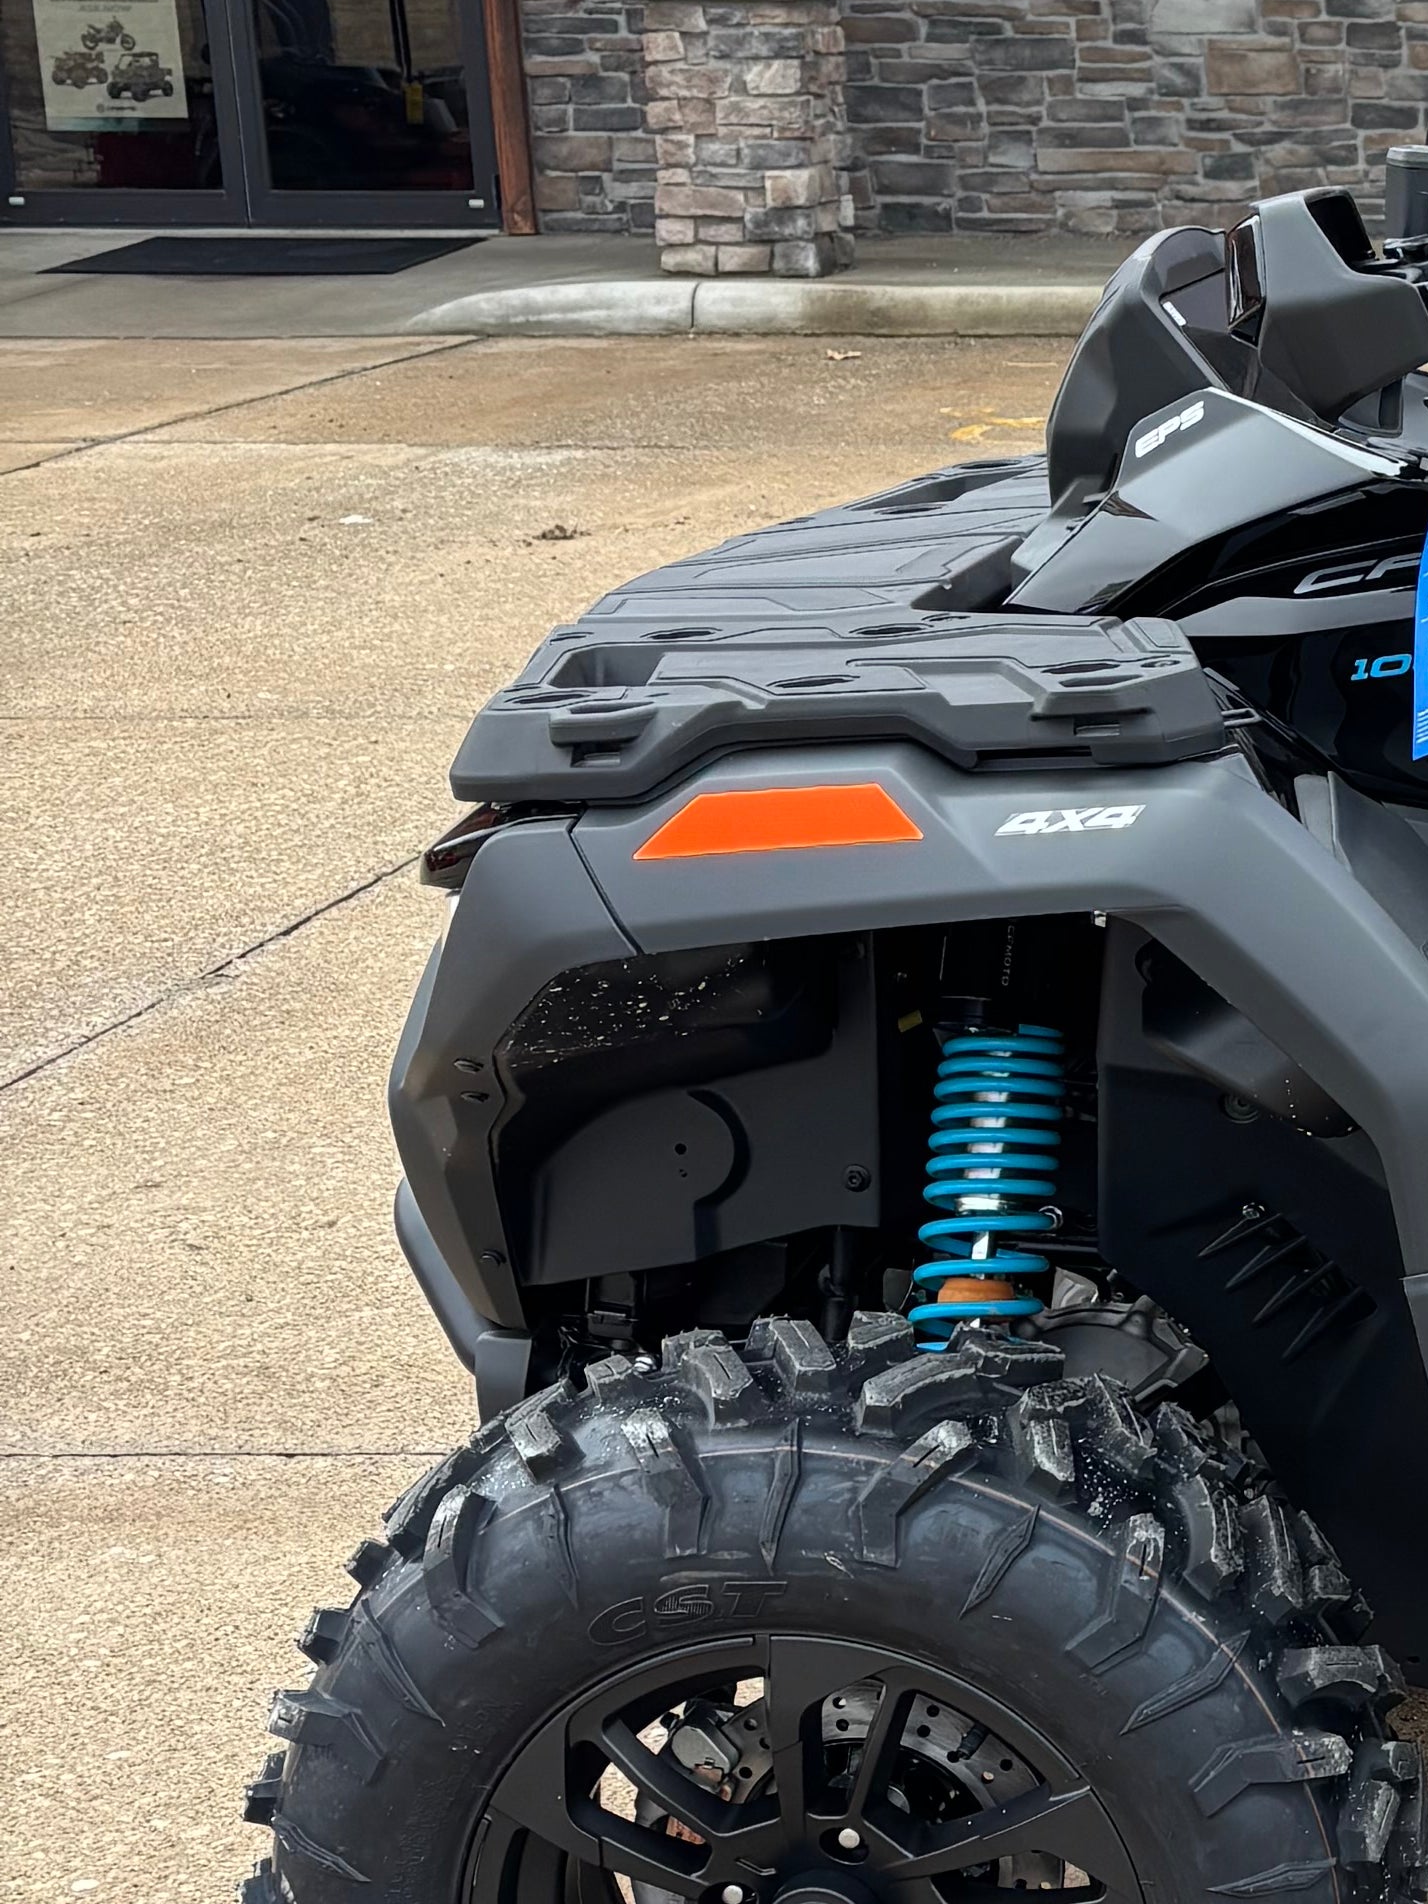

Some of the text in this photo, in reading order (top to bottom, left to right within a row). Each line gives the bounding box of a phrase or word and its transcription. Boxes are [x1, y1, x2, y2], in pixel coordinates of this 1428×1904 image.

[1135, 401, 1205, 458] EPS
[1002, 924, 1015, 986] CFMOTO
[587, 1581, 788, 1646] CST
